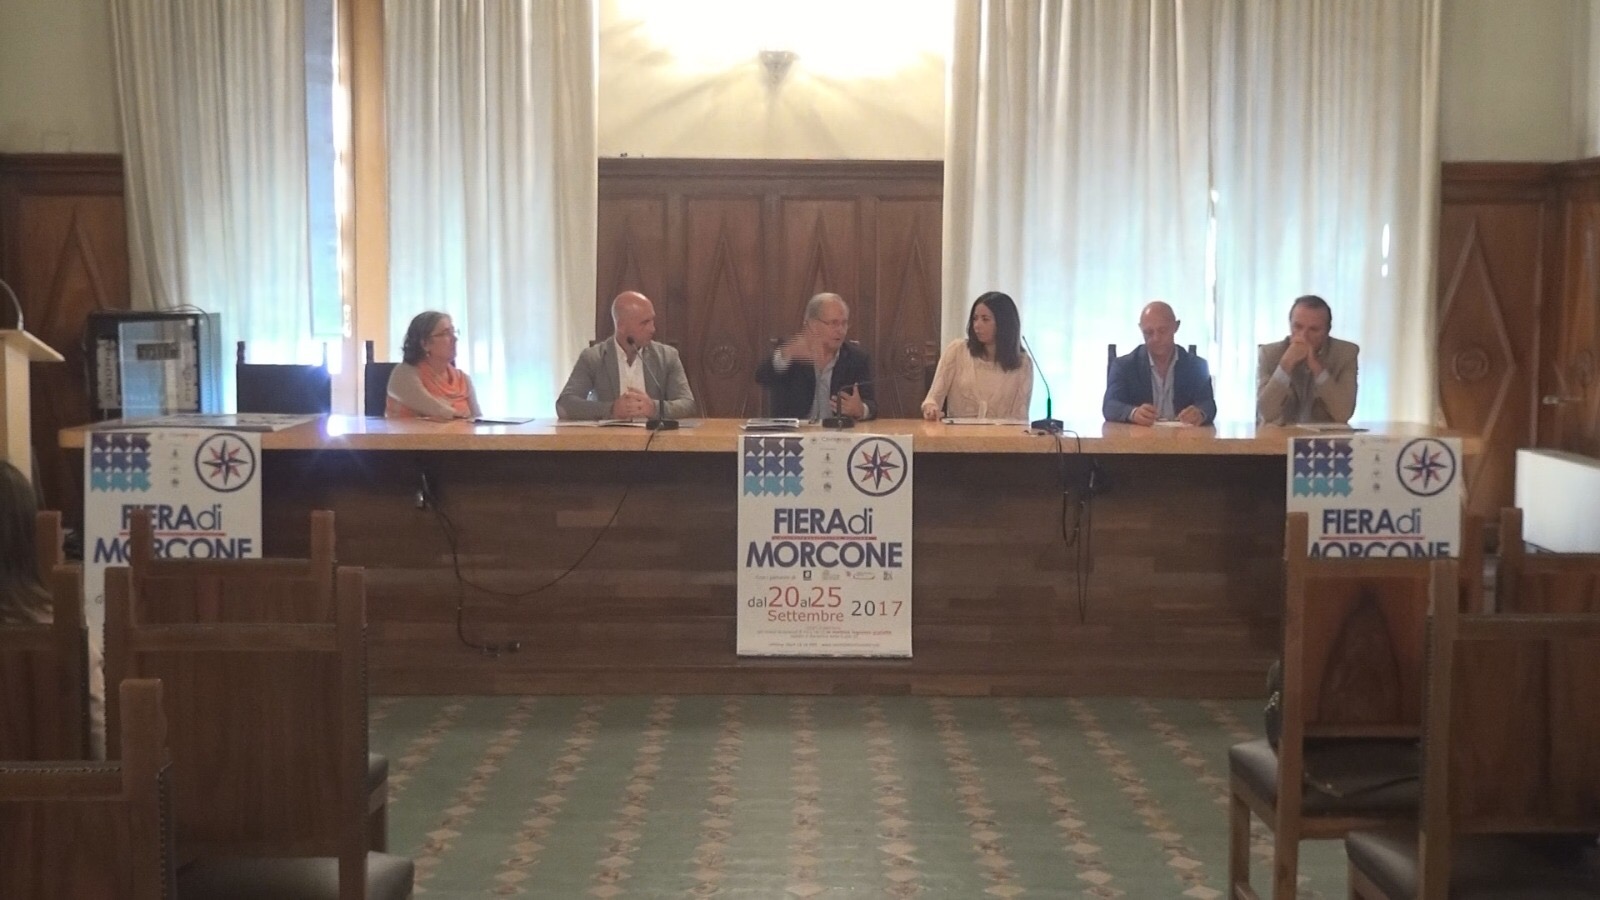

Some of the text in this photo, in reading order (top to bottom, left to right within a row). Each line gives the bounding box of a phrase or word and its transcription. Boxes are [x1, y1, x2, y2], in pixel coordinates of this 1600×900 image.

[94, 537, 252, 563] MRCONE
[746, 541, 902, 568] MORCONE
[768, 586, 800, 608] 20
[811, 586, 842, 608] 25
[768, 610, 844, 622] Settembre
[851, 600, 903, 617] 2017
